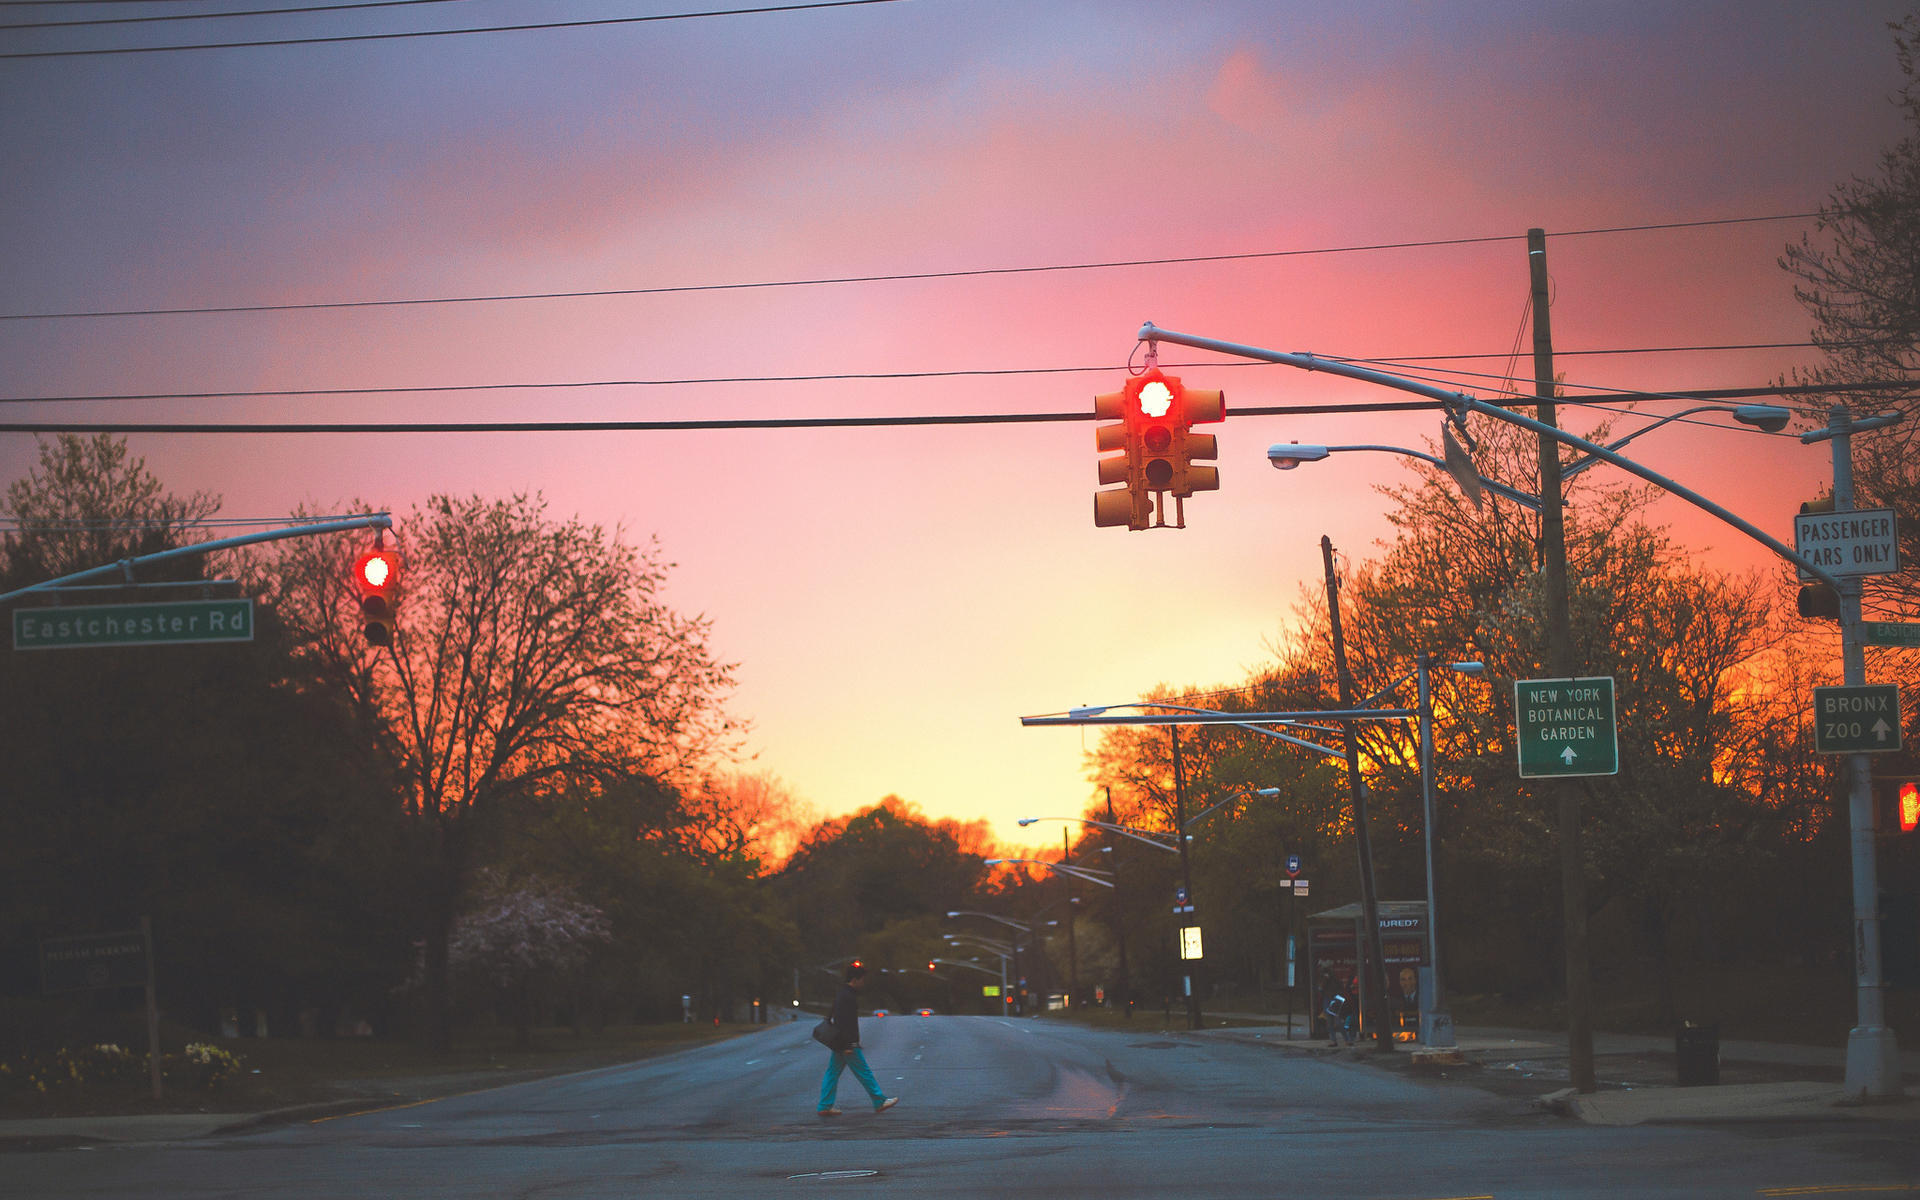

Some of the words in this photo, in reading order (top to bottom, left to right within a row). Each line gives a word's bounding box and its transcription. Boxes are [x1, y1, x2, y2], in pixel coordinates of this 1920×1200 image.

[1802, 519, 1890, 541] PASSENGER
[1853, 544, 1891, 563] ONLY
[22, 614, 198, 639] Eastchester
[209, 611, 243, 630] Rd
[1530, 690, 1558, 703] NEW
[1566, 688, 1601, 702] YORK
[1825, 696, 1888, 713] BRONX
[1528, 707, 1604, 723] BOTANICAL
[1541, 726, 1595, 740] GARDEN
[1825, 722, 1862, 739] ZOO
